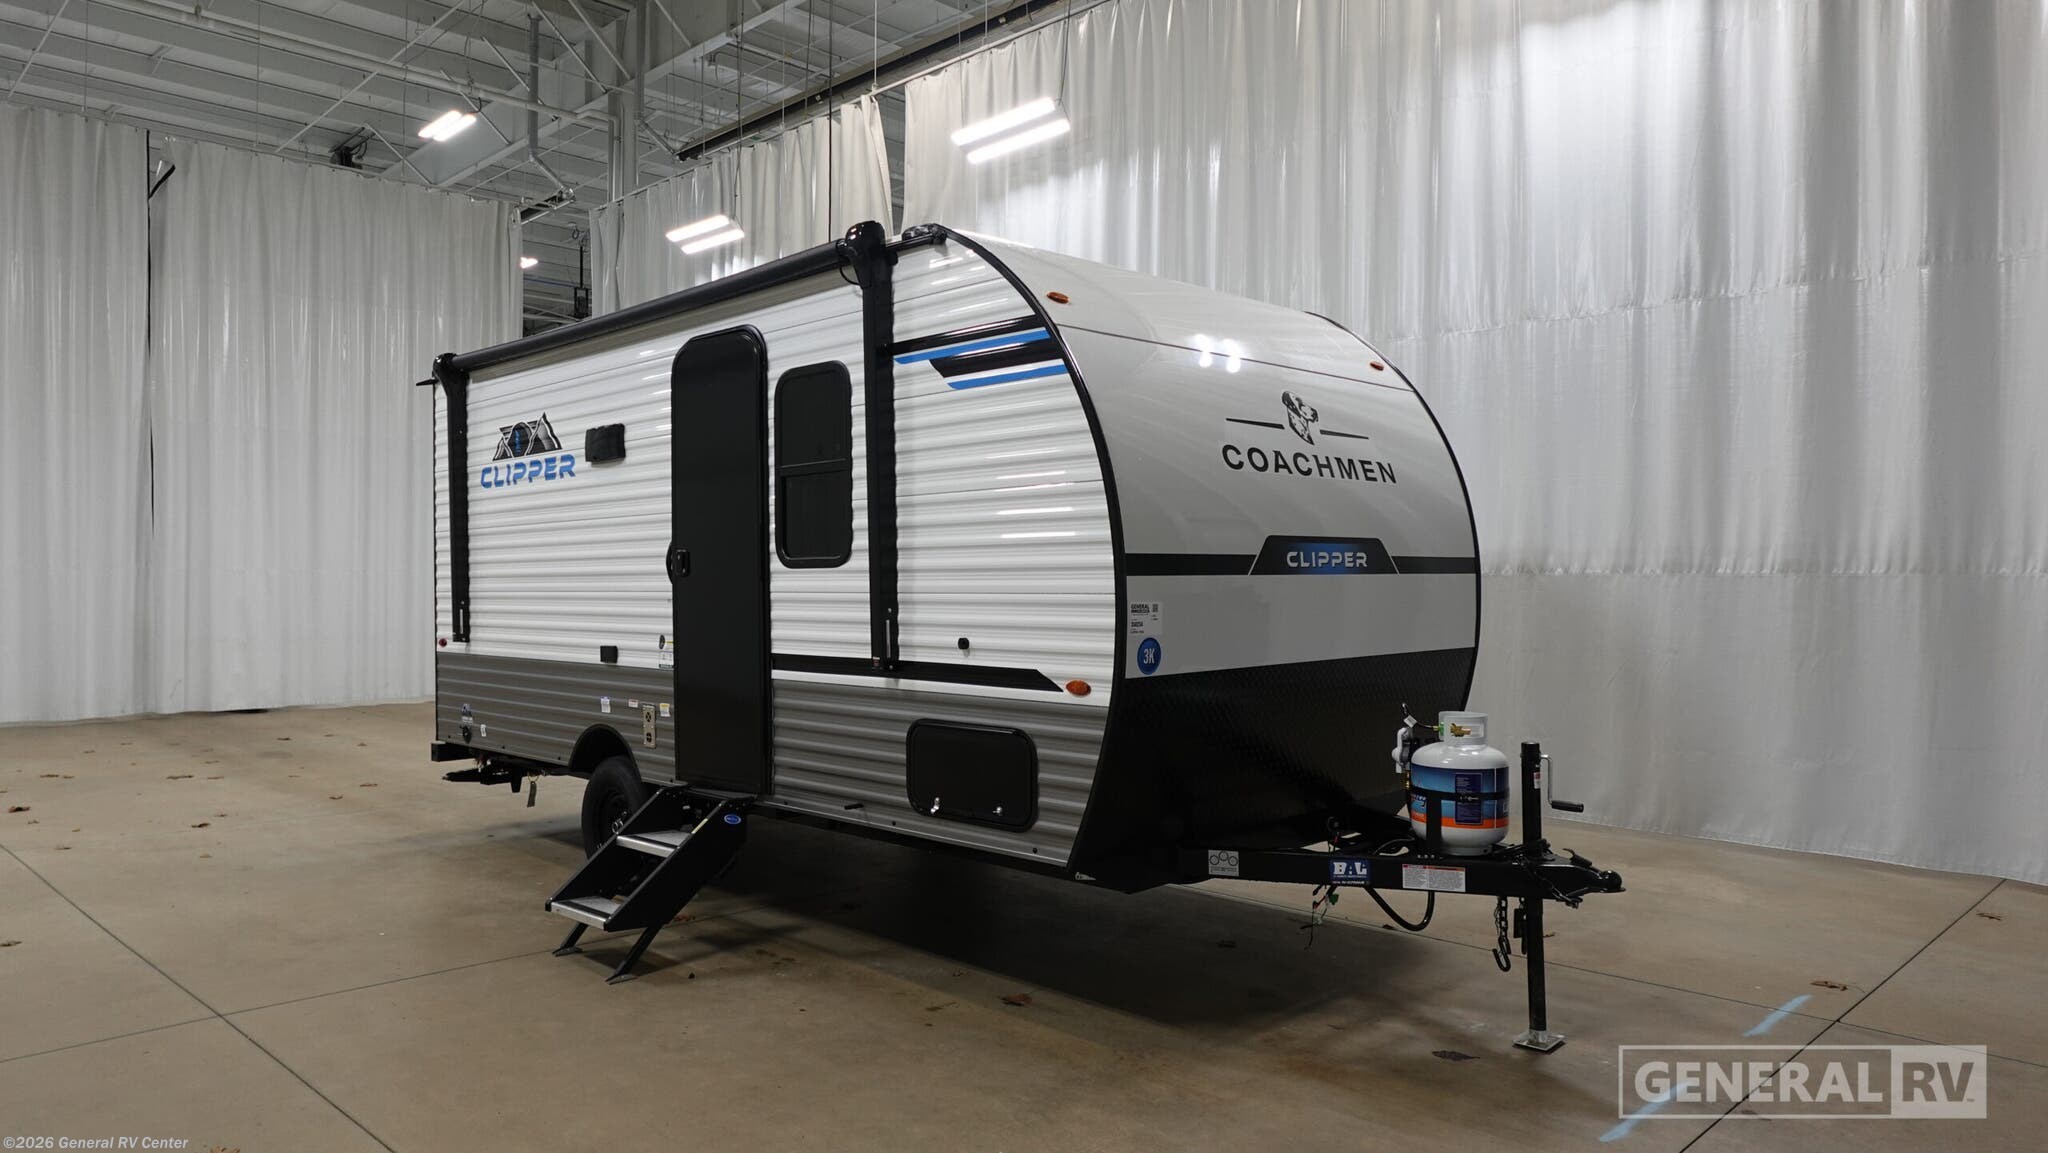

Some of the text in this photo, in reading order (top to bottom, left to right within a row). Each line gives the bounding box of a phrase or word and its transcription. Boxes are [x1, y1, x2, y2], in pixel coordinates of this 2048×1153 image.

[480, 453, 576, 489] CLIPPER
[1222, 444, 1397, 484] COACHMEN
[1286, 551, 1368, 568] CLIPPER
[1143, 648, 1155, 665] 3K
